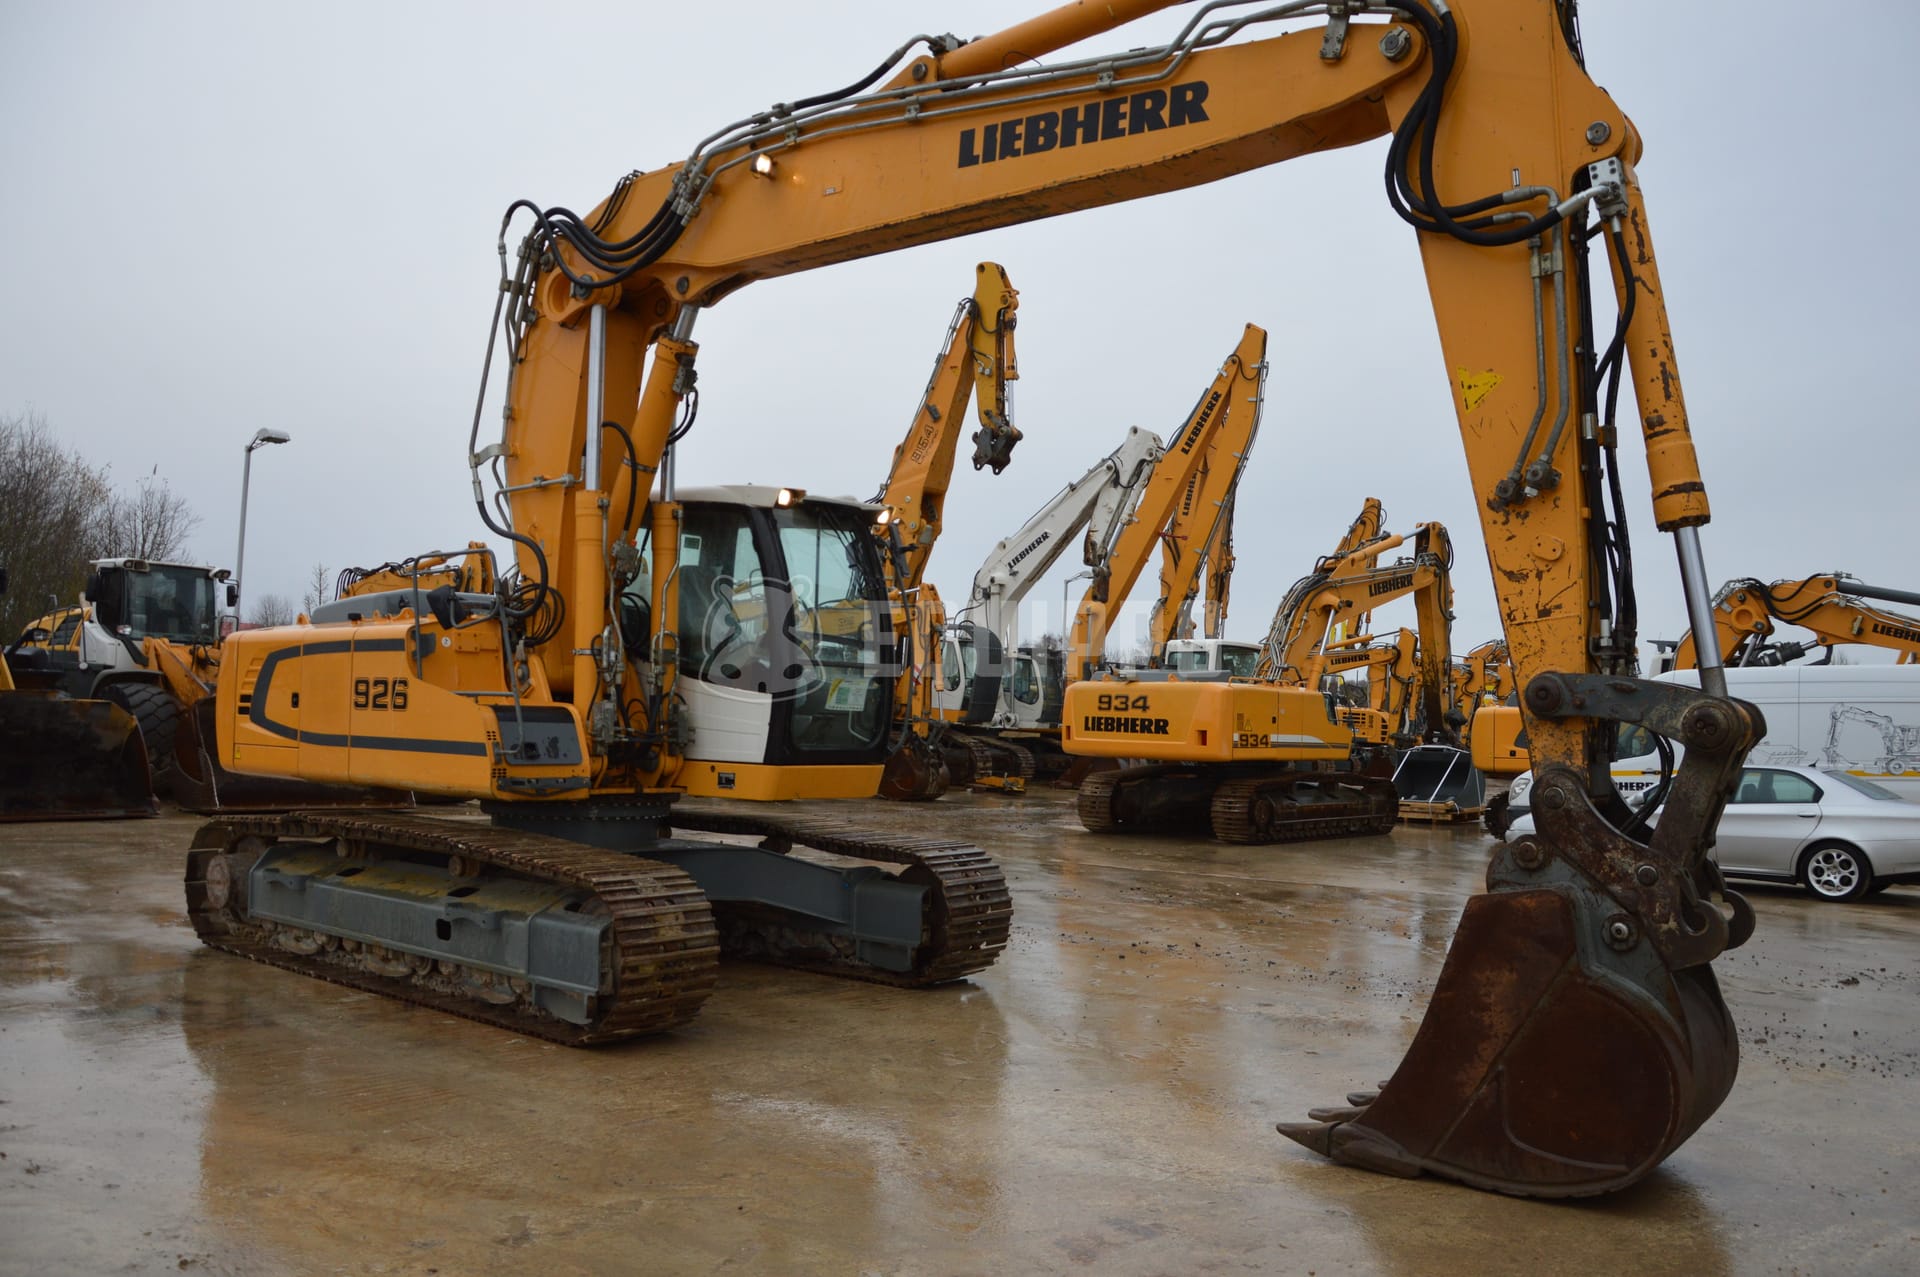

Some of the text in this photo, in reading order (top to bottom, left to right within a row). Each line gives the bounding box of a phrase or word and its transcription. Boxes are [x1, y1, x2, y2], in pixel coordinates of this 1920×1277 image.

[957, 80, 1210, 169] LIEBHERR
[1181, 391, 1222, 455] LIEBHERR
[1182, 472, 1198, 516] LIEBHER
[1007, 531, 1050, 569] LIEBHERR
[1368, 574, 1414, 597] LIEBHERR
[1331, 654, 1370, 665] LIEBHERR
[354, 678, 408, 711] 926
[1097, 695, 1150, 712] 934
[1084, 716, 1169, 735] LIEBHERR
[1239, 734, 1270, 747] 934
